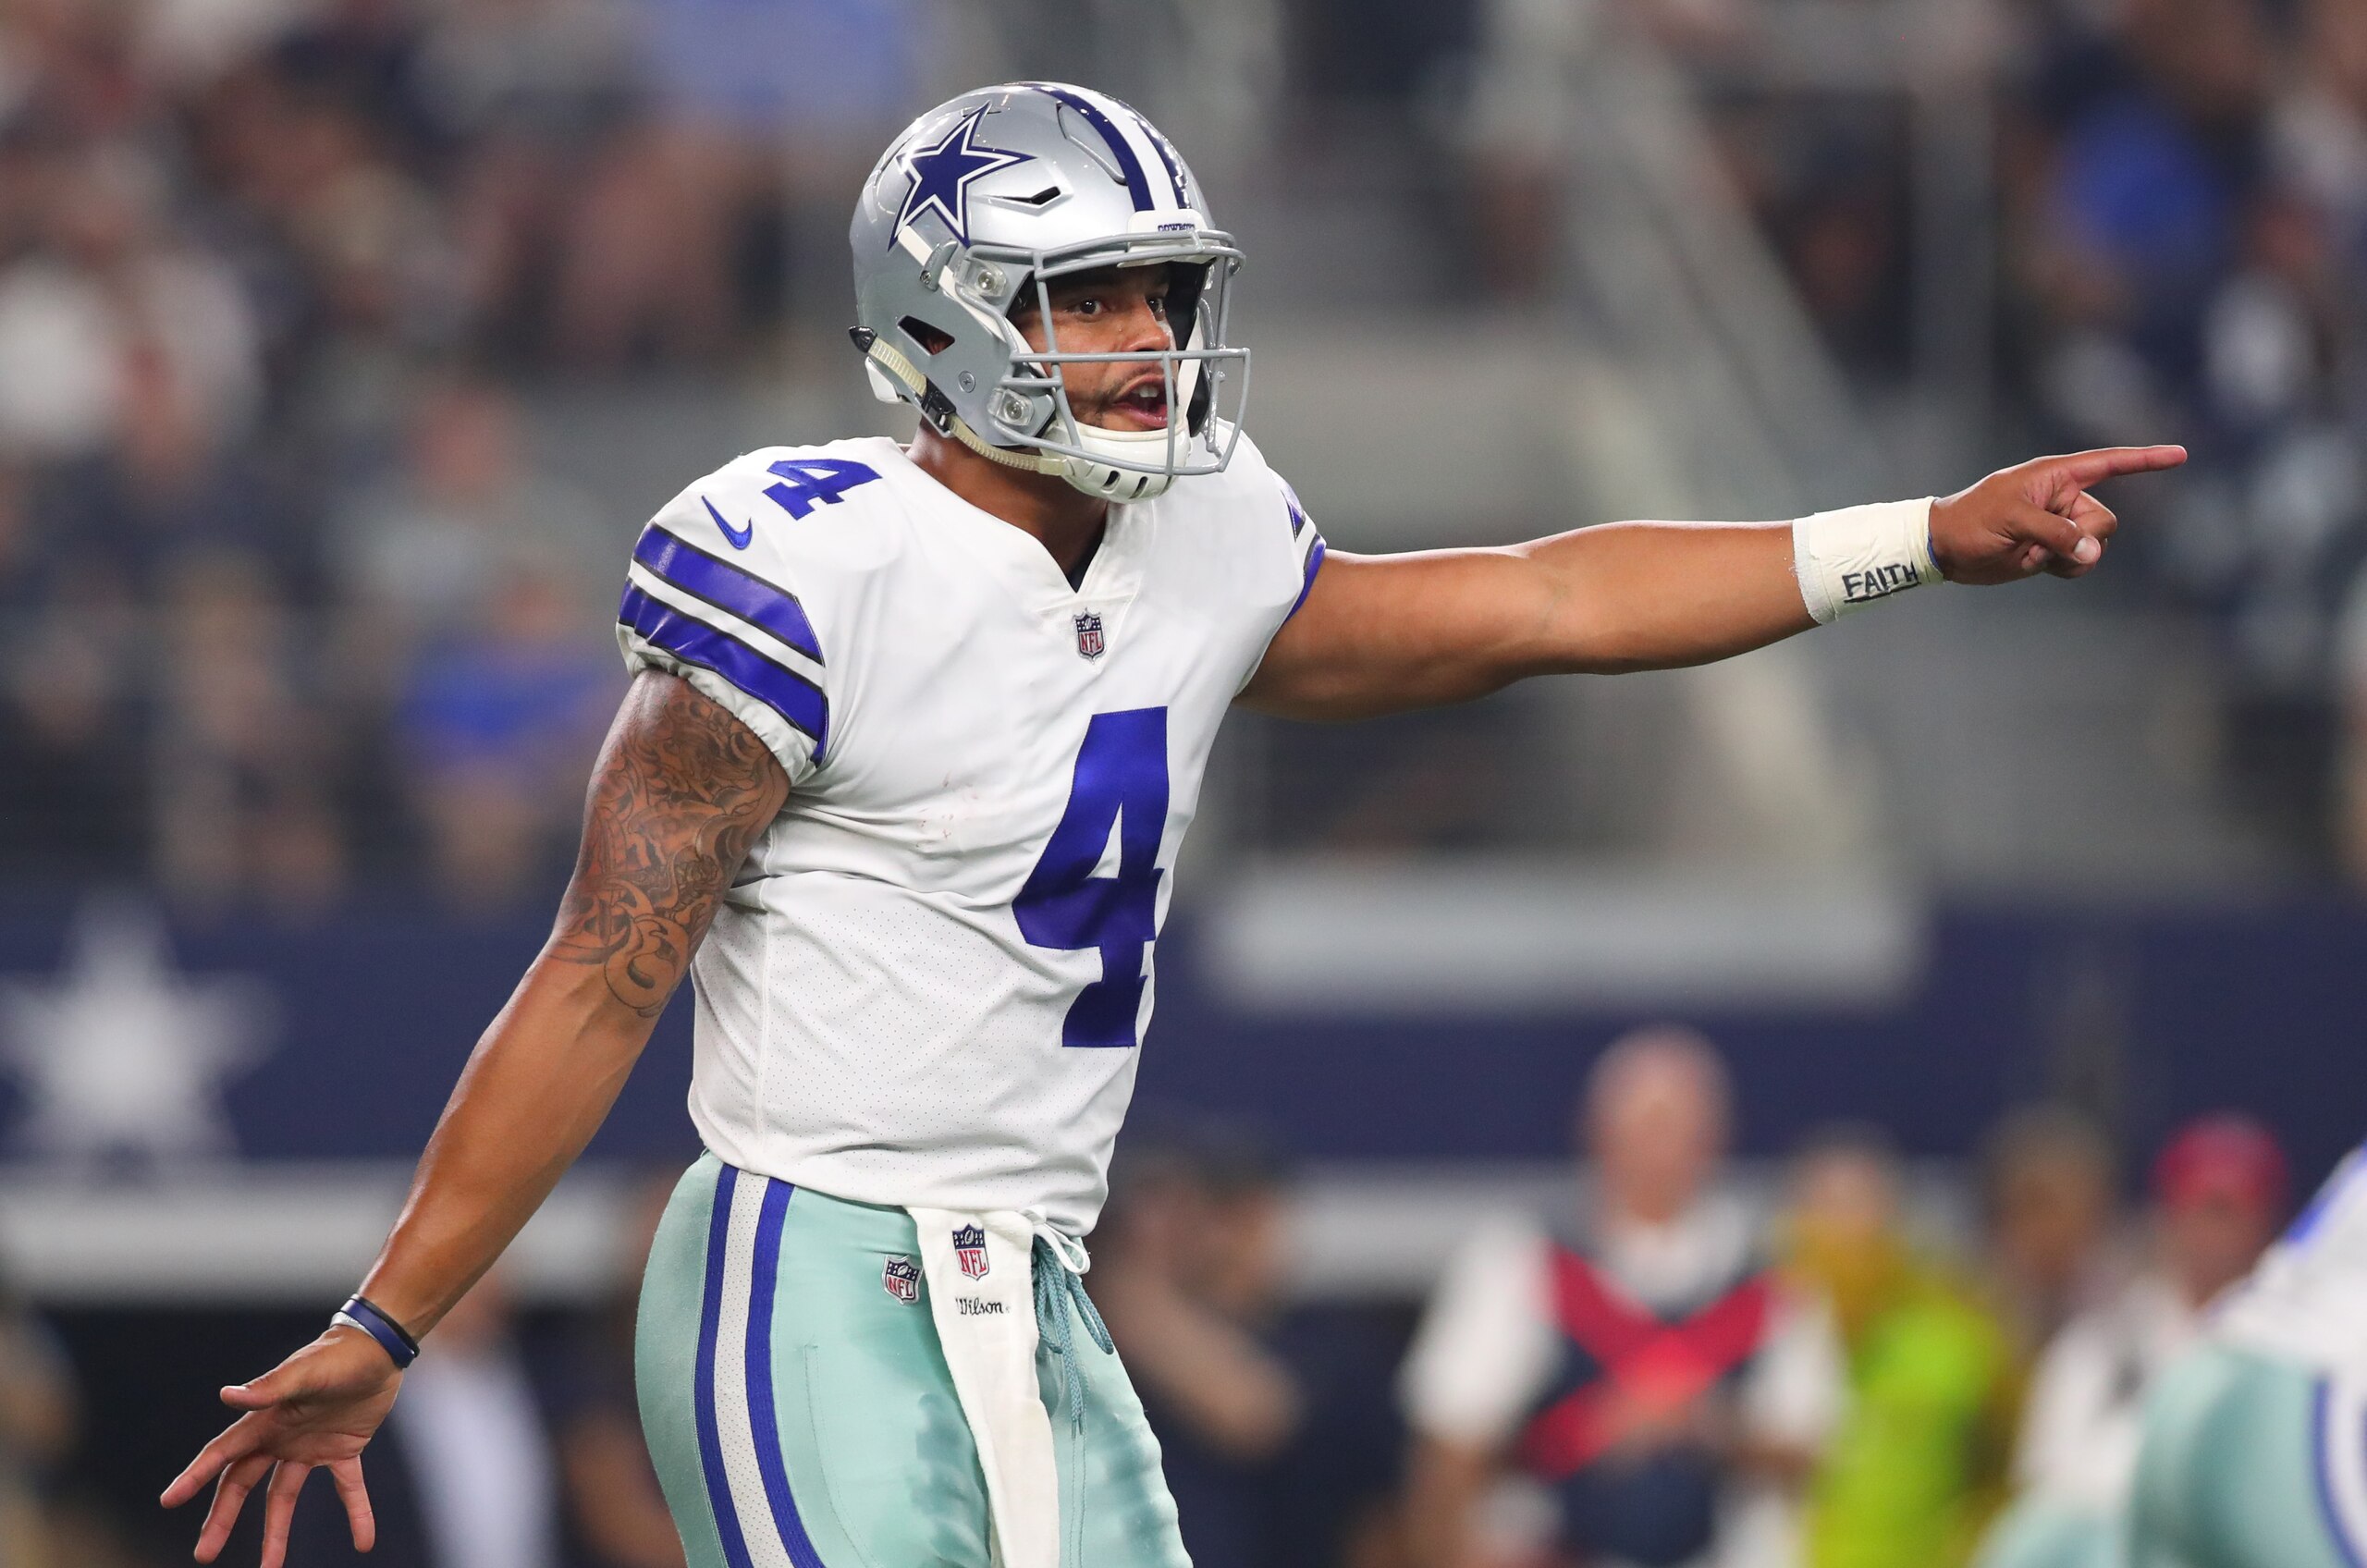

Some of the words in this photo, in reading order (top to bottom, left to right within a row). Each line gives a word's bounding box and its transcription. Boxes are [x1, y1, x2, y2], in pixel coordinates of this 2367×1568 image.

[762, 459, 882, 521] 4
[1842, 561, 1919, 597] FAITH
[1080, 631, 1102, 653] NFL
[1012, 706, 1169, 1047] 4
[957, 1250, 987, 1276] NFL
[888, 1276, 914, 1297] NFL
[955, 1297, 1003, 1316] Wilson
